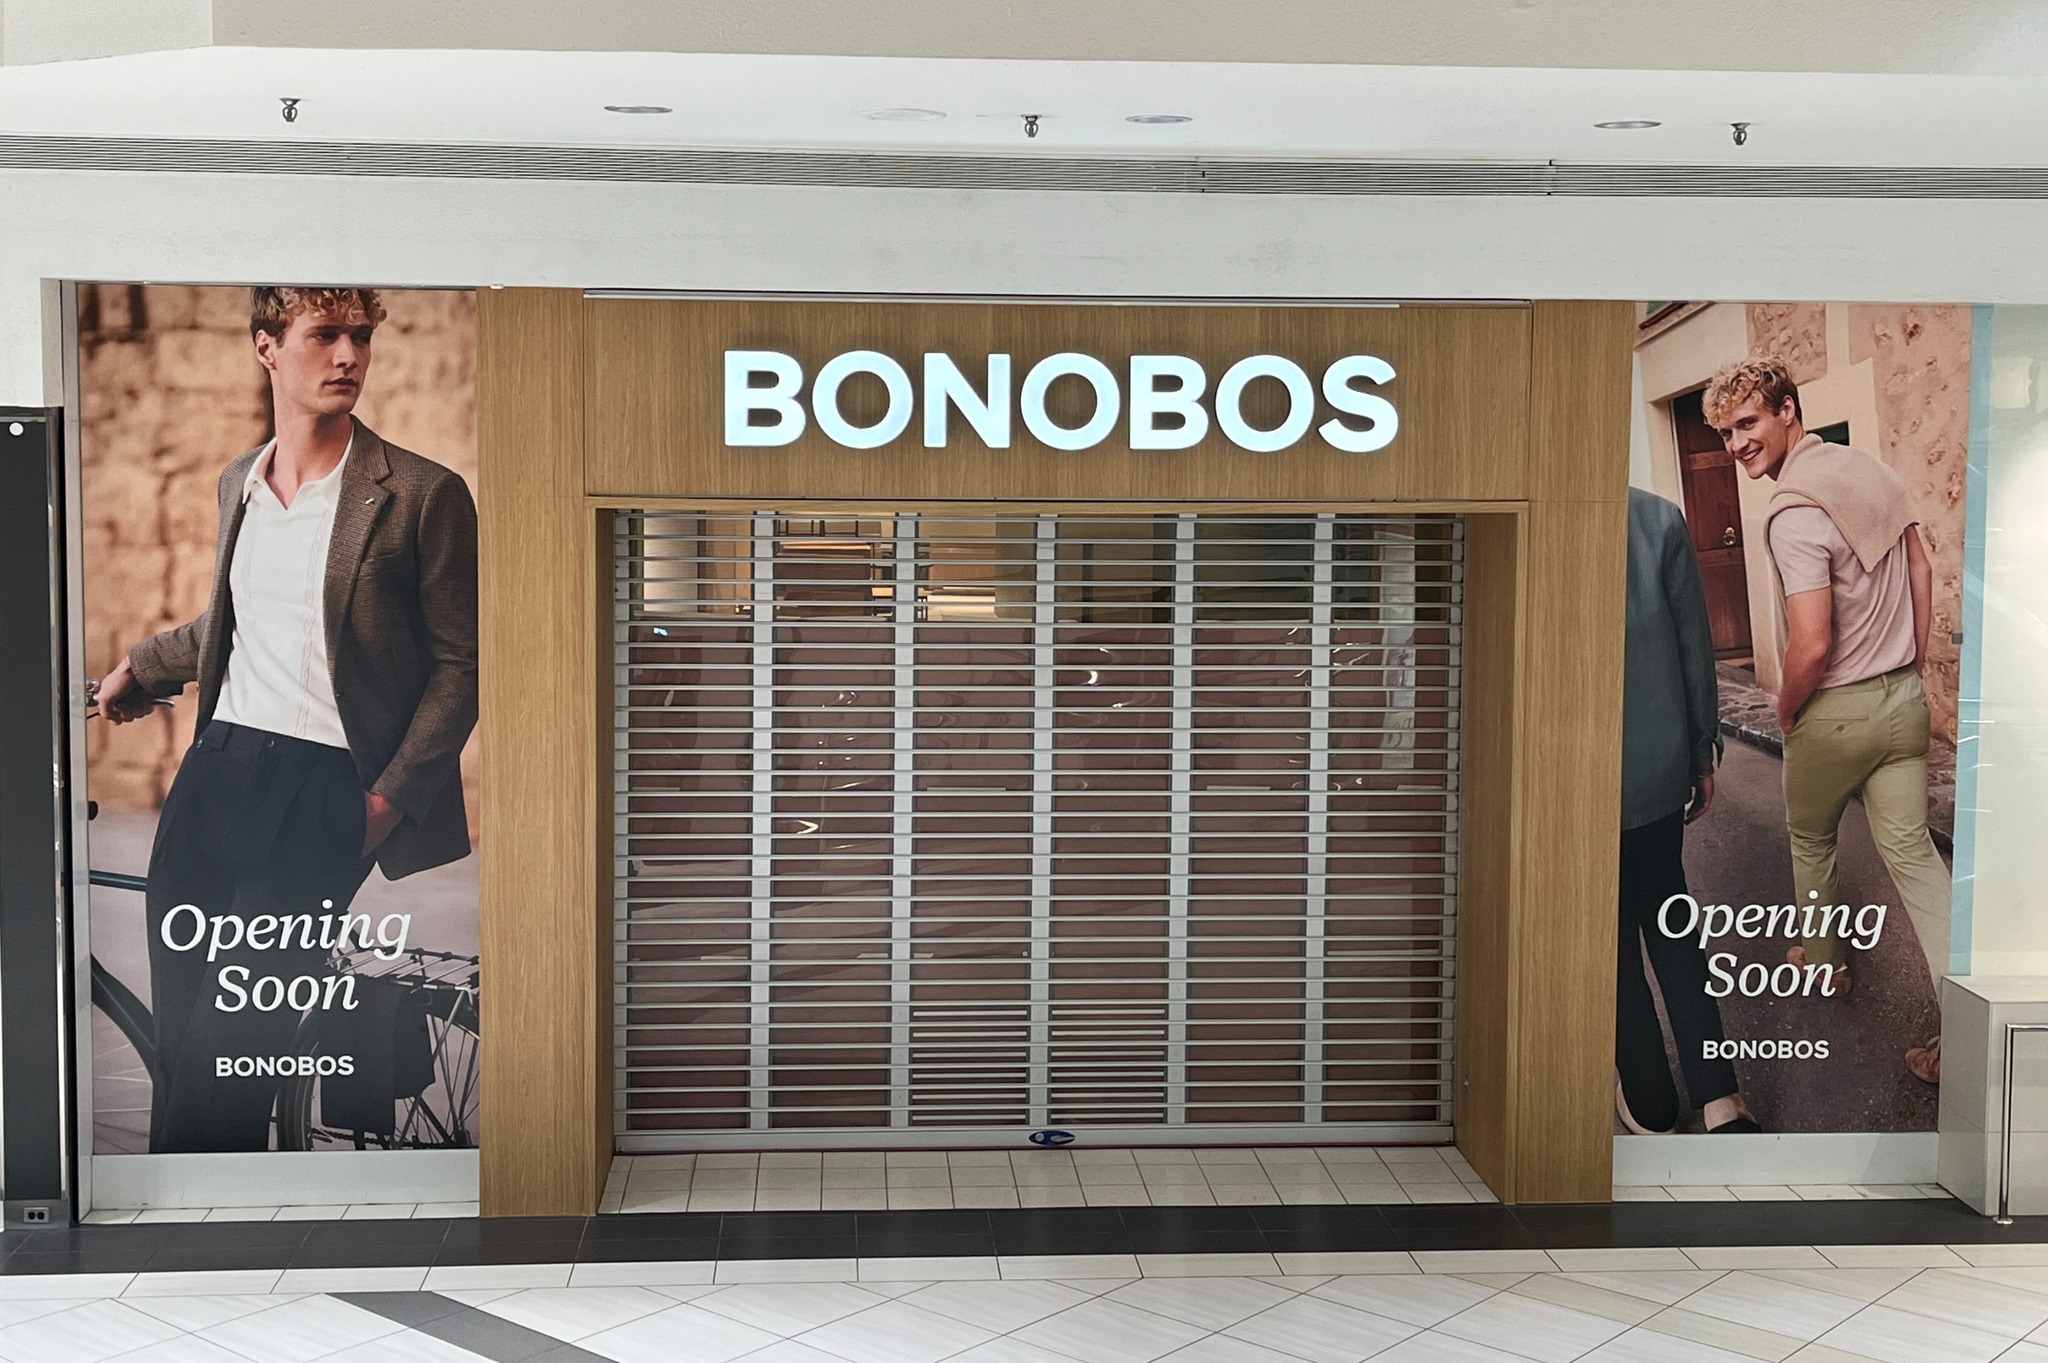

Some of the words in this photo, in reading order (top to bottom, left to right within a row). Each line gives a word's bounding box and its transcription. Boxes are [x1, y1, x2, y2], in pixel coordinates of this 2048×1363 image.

[724, 350, 1399, 453] BONOBOS
[161, 899, 412, 962] Opening
[1657, 890, 1888, 950] Opening
[214, 965, 359, 1012] Soon
[1704, 952, 1836, 998] Soon
[215, 1055, 355, 1077] BONOBOS
[1702, 1040, 1830, 1060] BONOBOS
